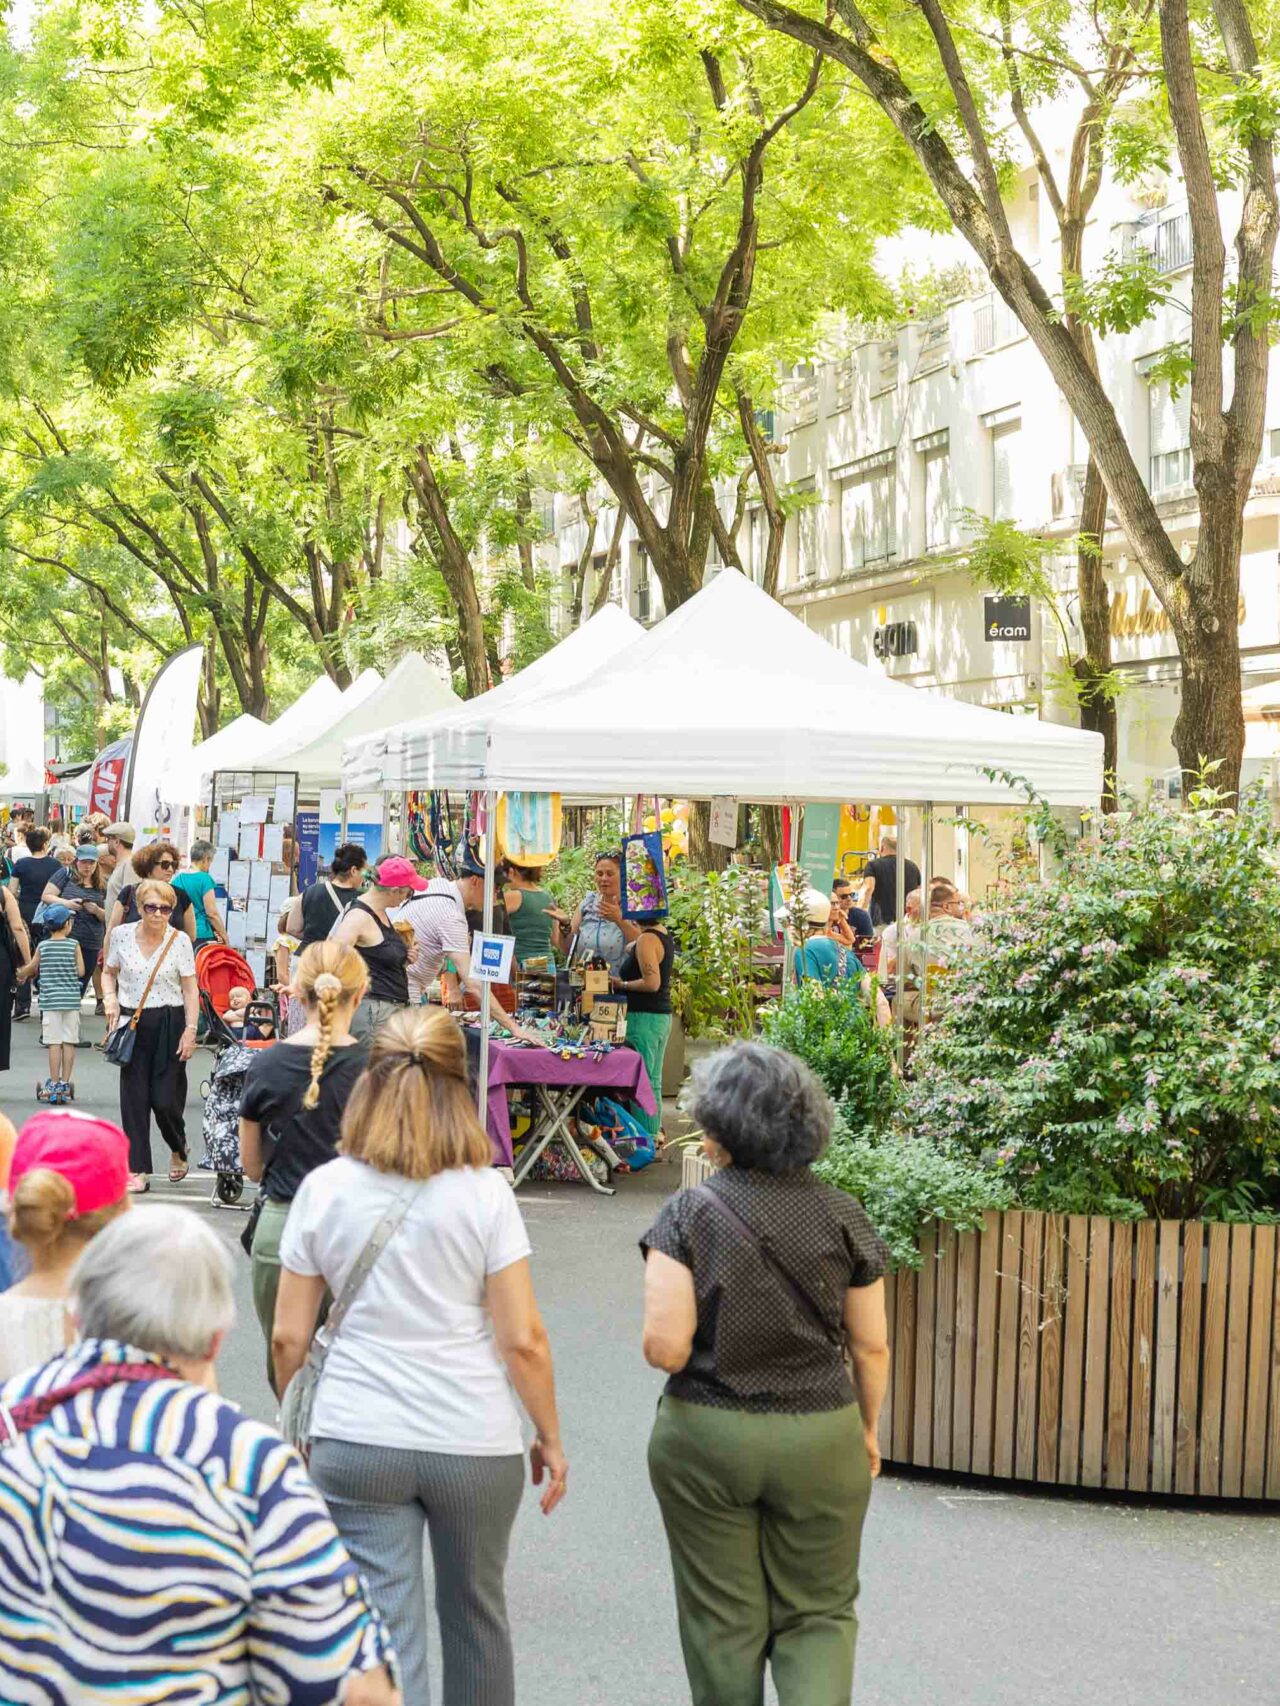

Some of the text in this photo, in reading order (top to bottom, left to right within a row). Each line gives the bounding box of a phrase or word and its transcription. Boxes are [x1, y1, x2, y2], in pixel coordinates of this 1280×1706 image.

[989, 622, 1027, 637] éram
[94, 760, 118, 818] AIF
[598, 1005, 610, 1016] 56
